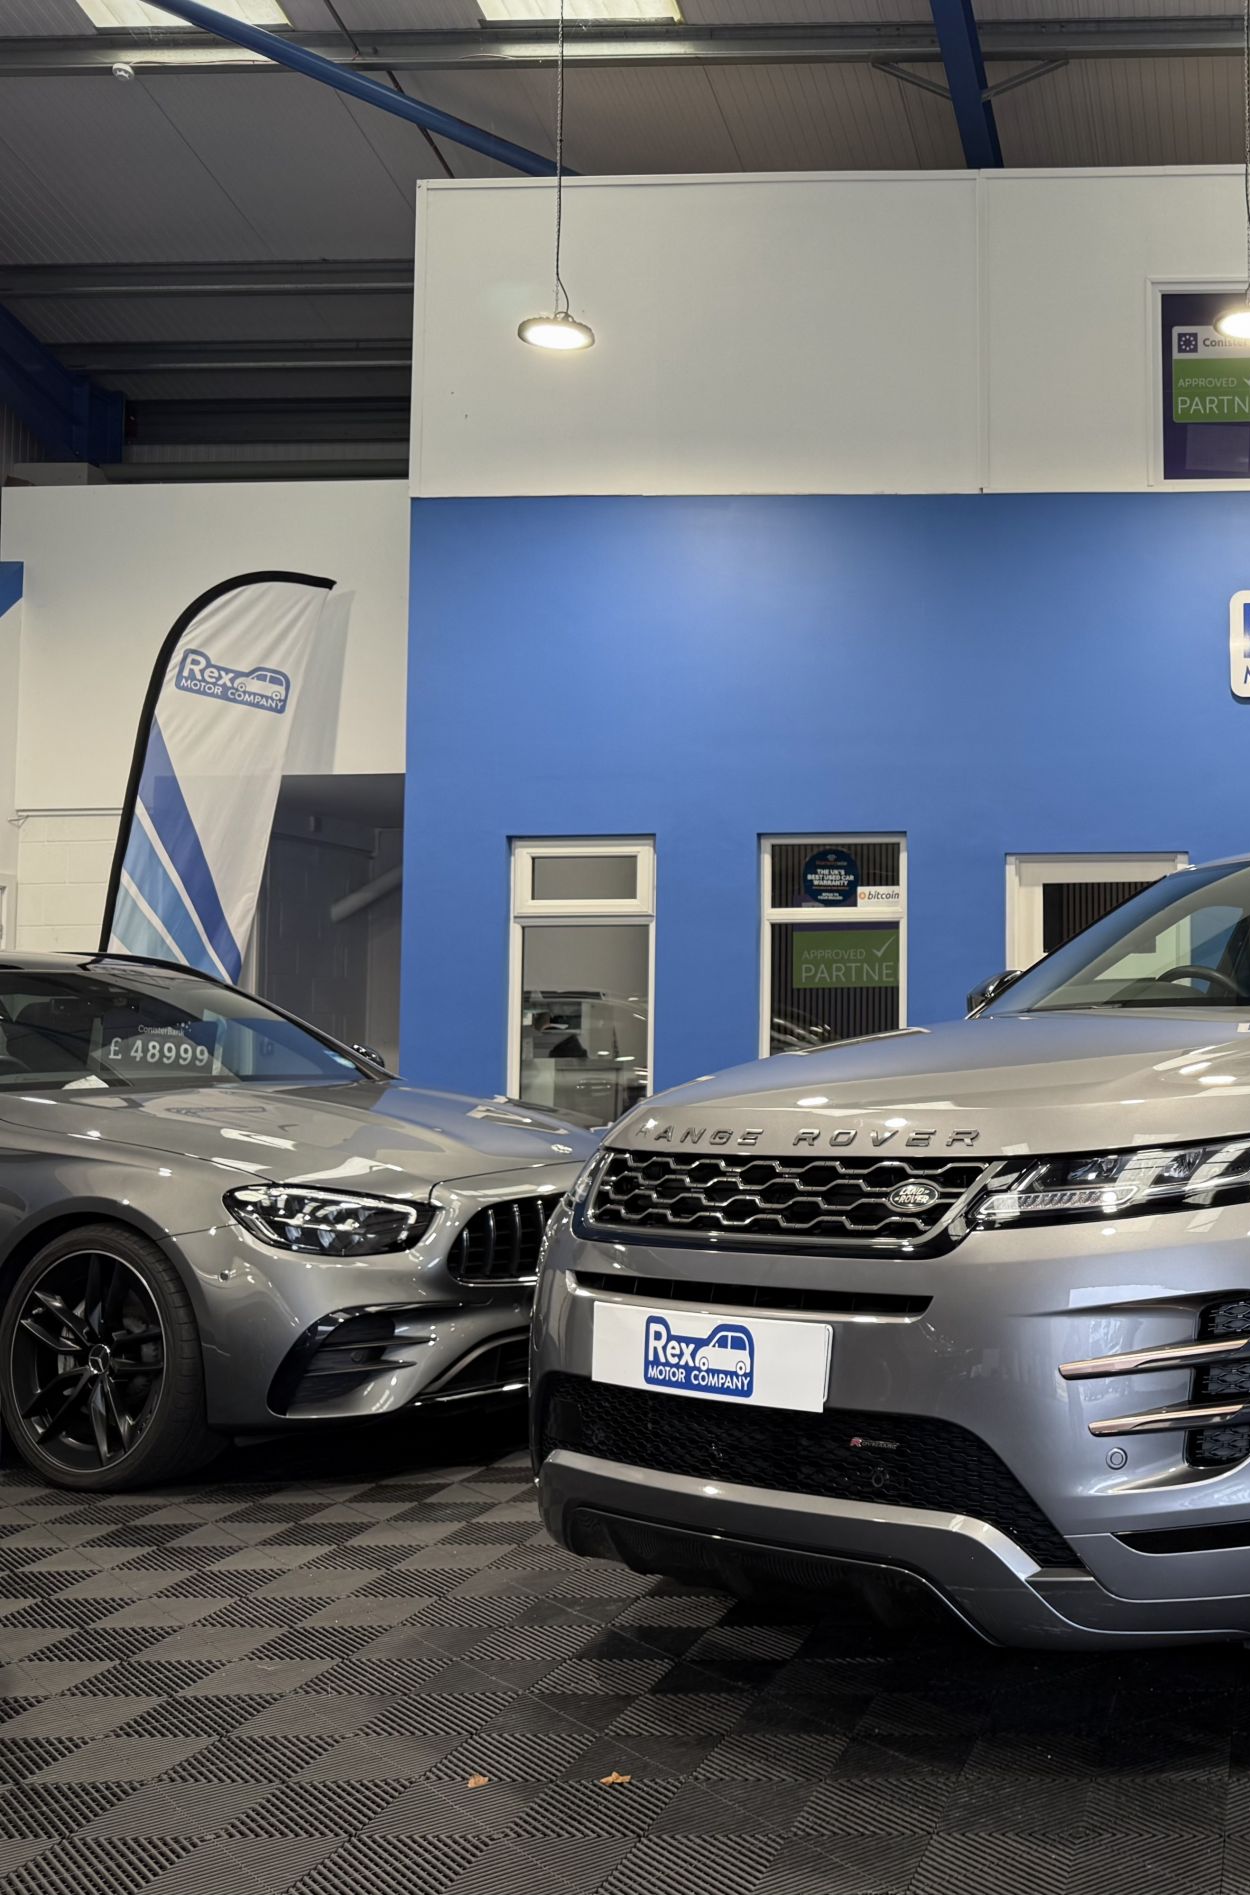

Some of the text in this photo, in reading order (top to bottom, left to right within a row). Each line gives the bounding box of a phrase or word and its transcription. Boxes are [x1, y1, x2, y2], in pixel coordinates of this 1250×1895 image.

[1177, 377, 1237, 388] APPROVED
[182, 653, 235, 687] Rex
[180, 679, 284, 710] MOTOR COMPANY
[867, 890, 900, 900] bitcoin
[802, 949, 865, 960] APPROVED
[801, 962, 895, 983] PARTNE
[108, 1037, 209, 1067] £ 48999
[792, 1128, 980, 1148] ROVER
[898, 1195, 929, 1203] ROVER
[899, 1185, 925, 1195] LAND
[648, 1322, 697, 1367] Rex
[647, 1364, 750, 1391] MOTOR COMPANY
